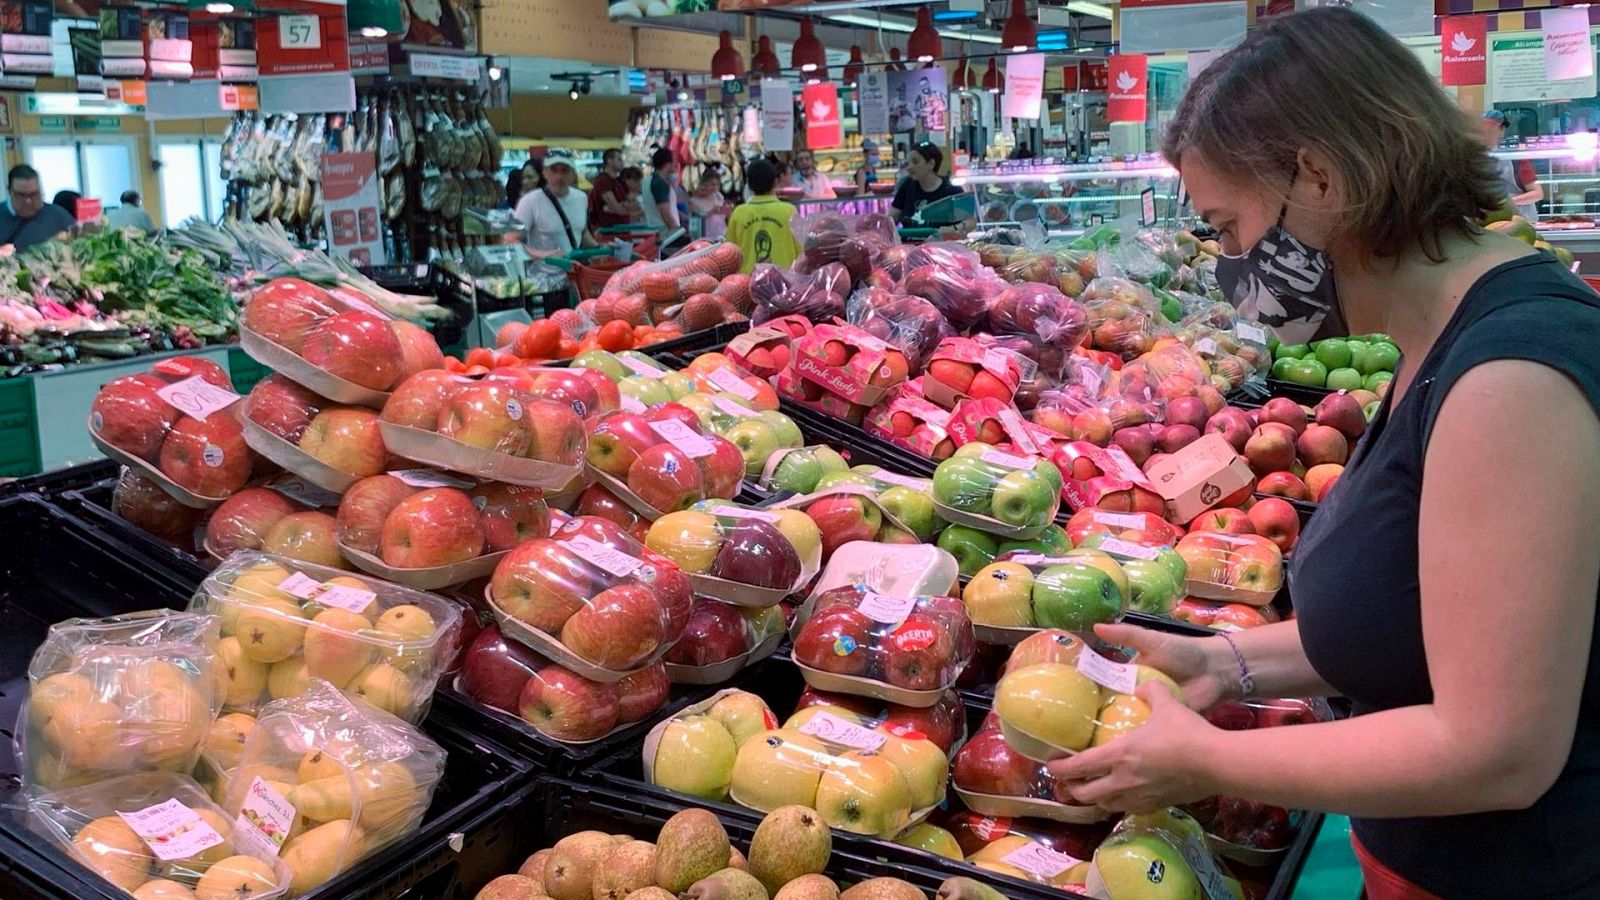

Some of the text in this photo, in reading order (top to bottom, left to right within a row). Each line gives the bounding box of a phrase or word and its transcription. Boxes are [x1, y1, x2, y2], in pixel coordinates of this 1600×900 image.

[289, 25, 311, 44] 57
[1443, 54, 1486, 64] Aniversario
[1109, 92, 1146, 100] Aniversario
[799, 359, 857, 396] Pink Lady
[952, 422, 969, 444] Pin
[896, 629, 934, 647] OFERTA
